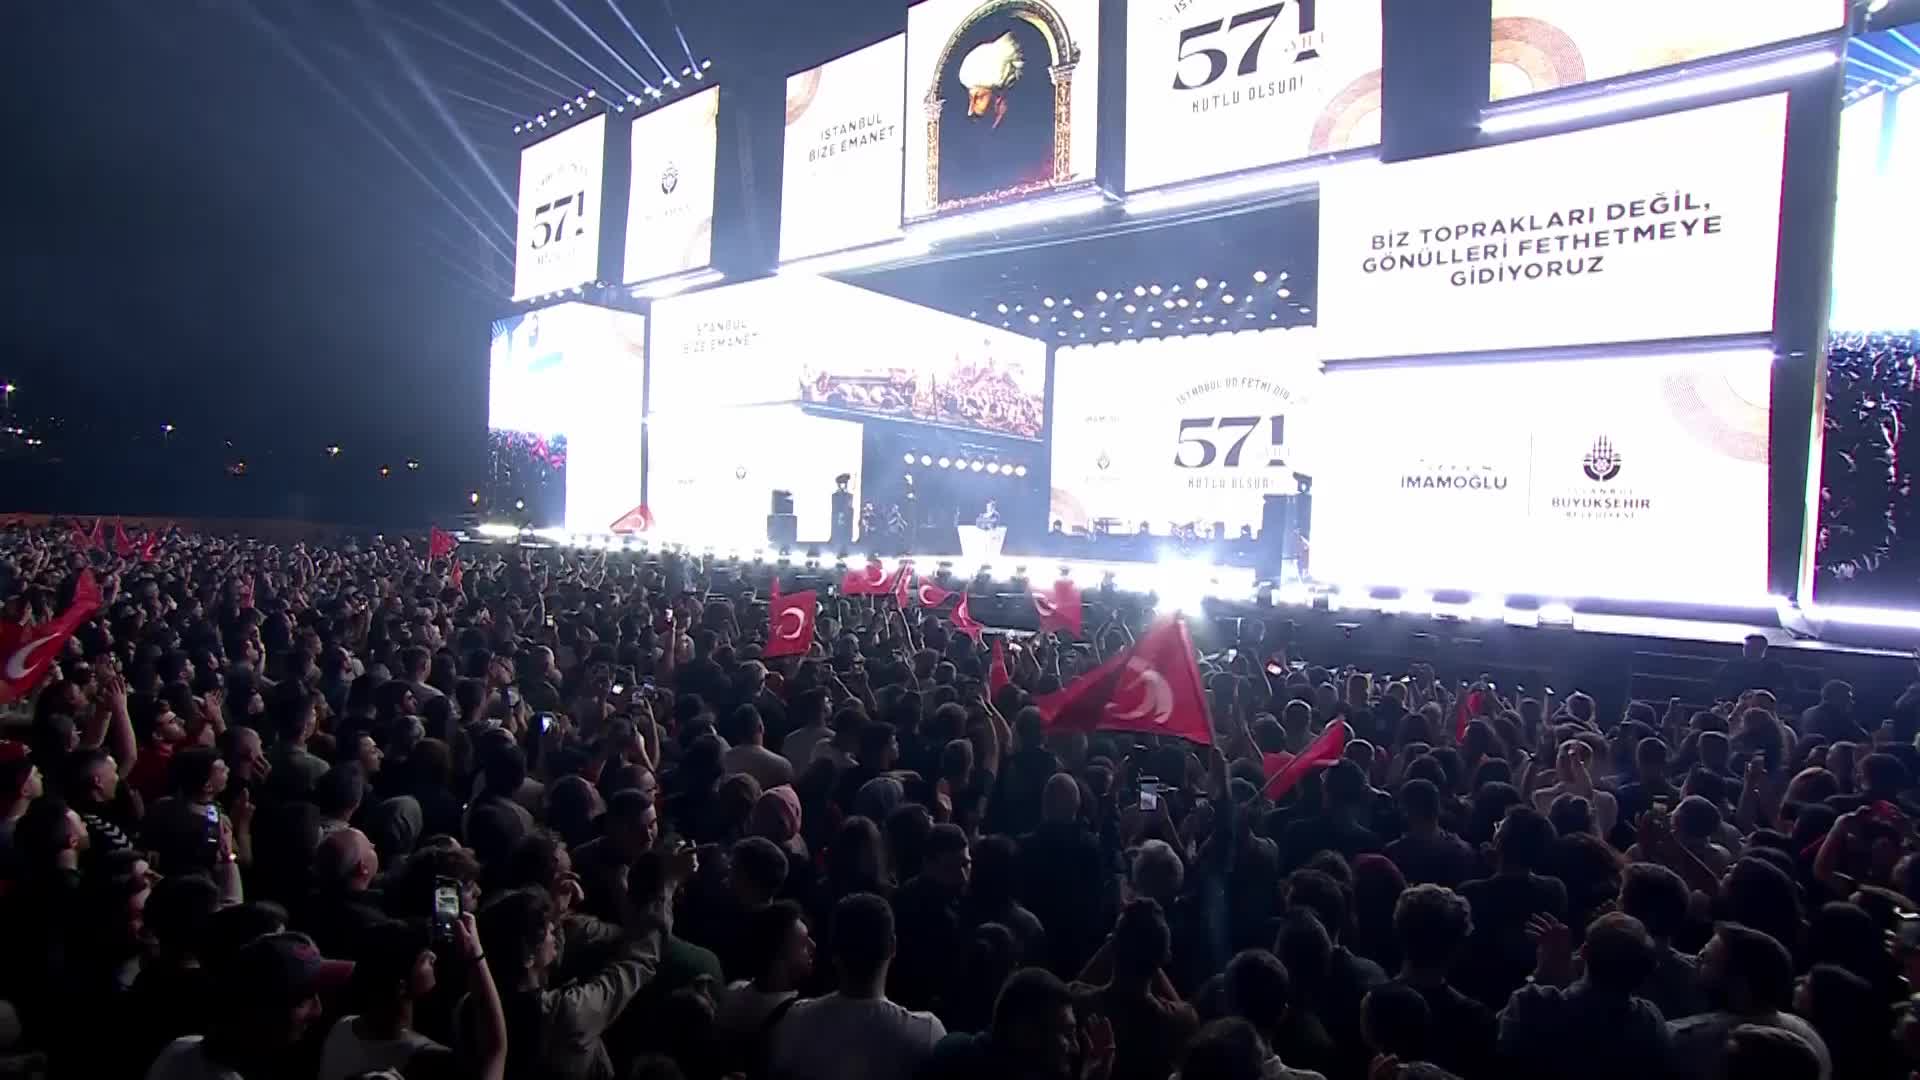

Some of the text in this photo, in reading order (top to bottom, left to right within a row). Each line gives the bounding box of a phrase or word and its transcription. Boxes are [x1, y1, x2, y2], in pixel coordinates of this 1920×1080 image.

[840, 124, 895, 153] EMANET
[1372, 189, 1711, 251] BİZ TOPRAKLARI DEĞİL,
[1362, 215, 1722, 274] GÖNÜLLERİ FETHETMEYE
[1450, 255, 1605, 287] GİDİYORUZ
